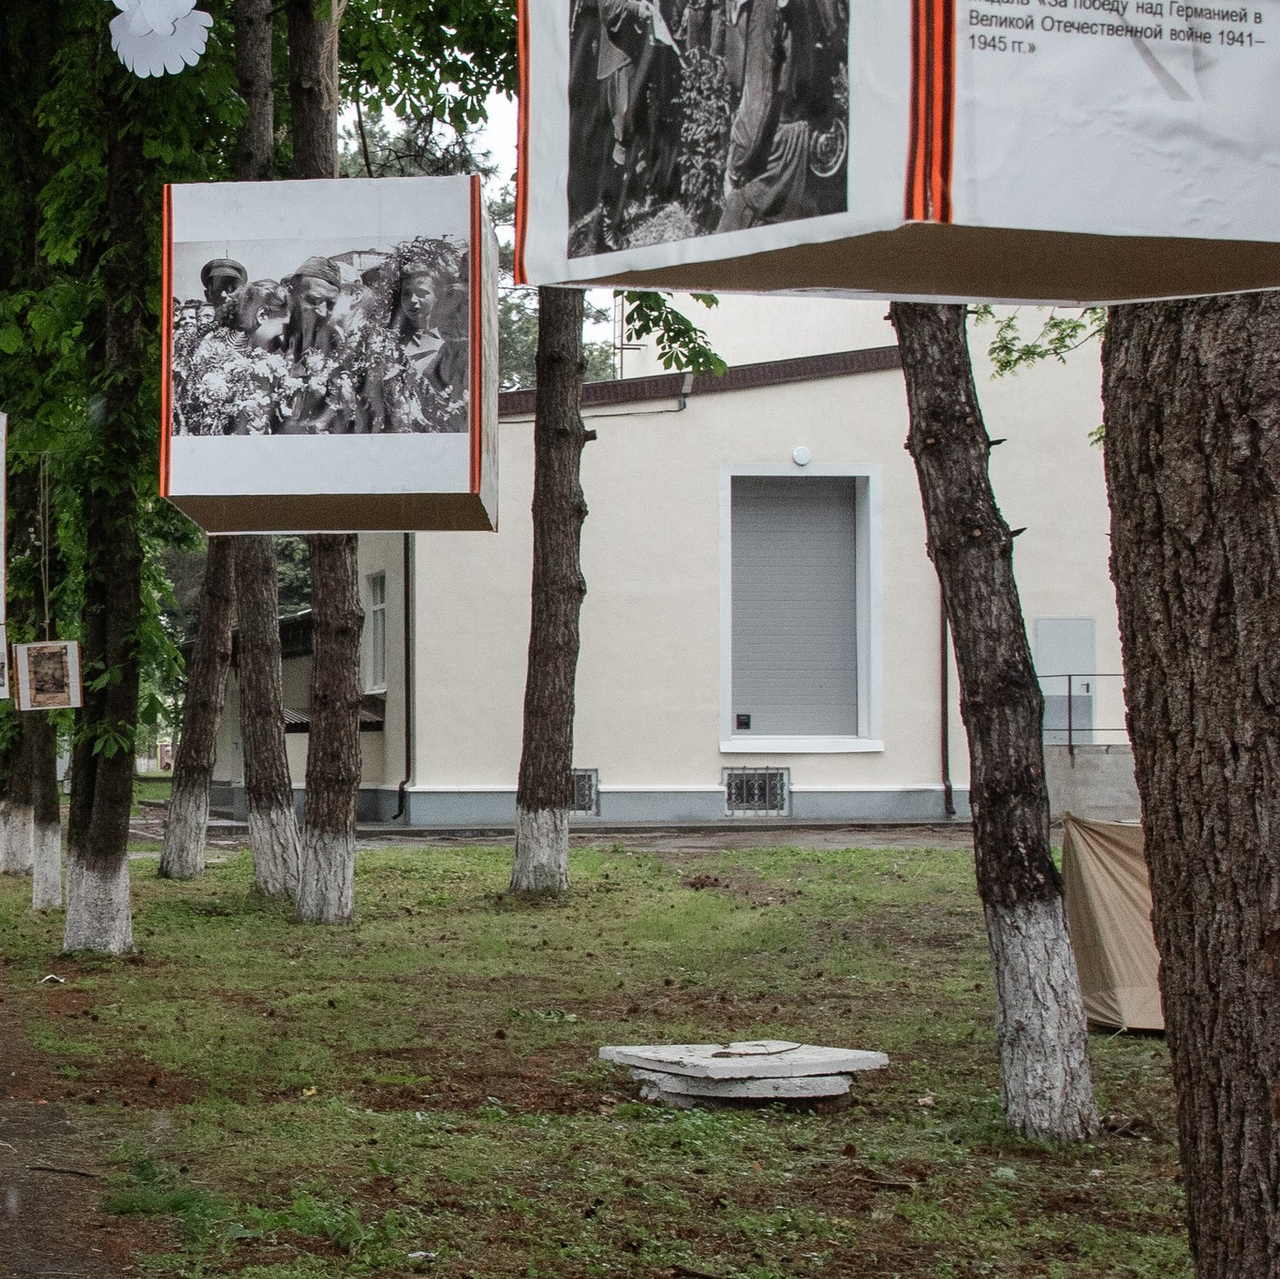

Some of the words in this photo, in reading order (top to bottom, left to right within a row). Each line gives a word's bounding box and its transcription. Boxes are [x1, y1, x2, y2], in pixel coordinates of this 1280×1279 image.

[1136, 3, 1162, 17] над
[1169, 1, 1248, 22] Германией
[1254, 12, 1262, 23] в
[969, 10, 1033, 31] Великой
[1041, 15, 1162, 40] Отечественной
[1170, 27, 1211, 44] войне
[1218, 31, 1265, 47] 1941–
[969, 35, 1006, 52] 1945
